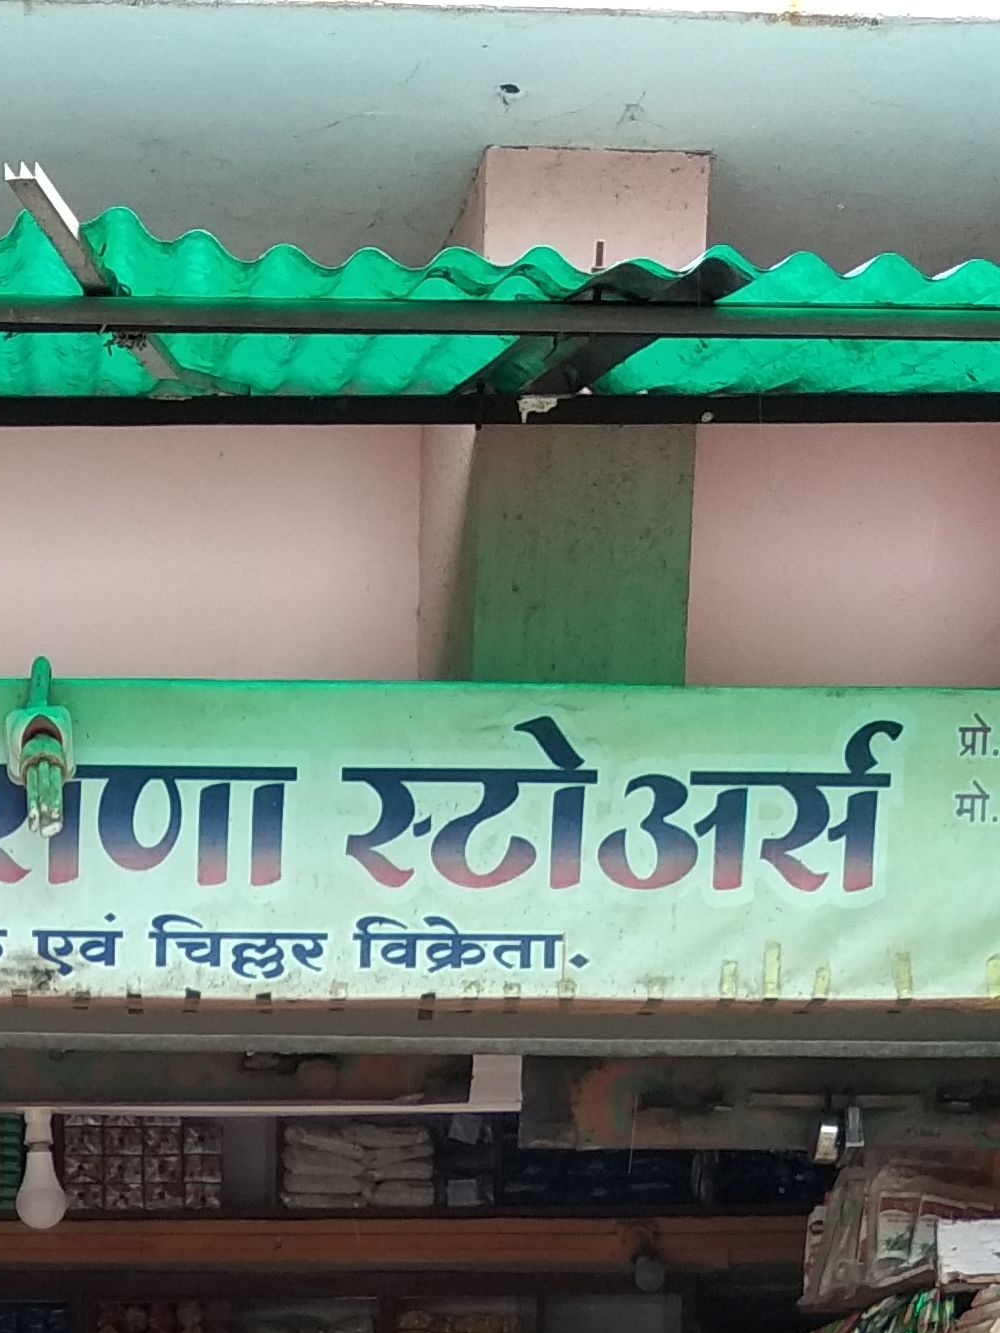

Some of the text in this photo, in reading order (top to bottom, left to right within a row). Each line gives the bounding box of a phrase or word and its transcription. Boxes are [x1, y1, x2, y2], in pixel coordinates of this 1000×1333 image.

[958, 712, 1000, 757] प्रो.
[343, 715, 904, 893] स्टोअर्स
[954, 779, 999, 823] मो.
[32, 913, 124, 977] एवं
[149, 914, 328, 978] चिल्लर
[353, 916, 590, 973] विक्रेता.
